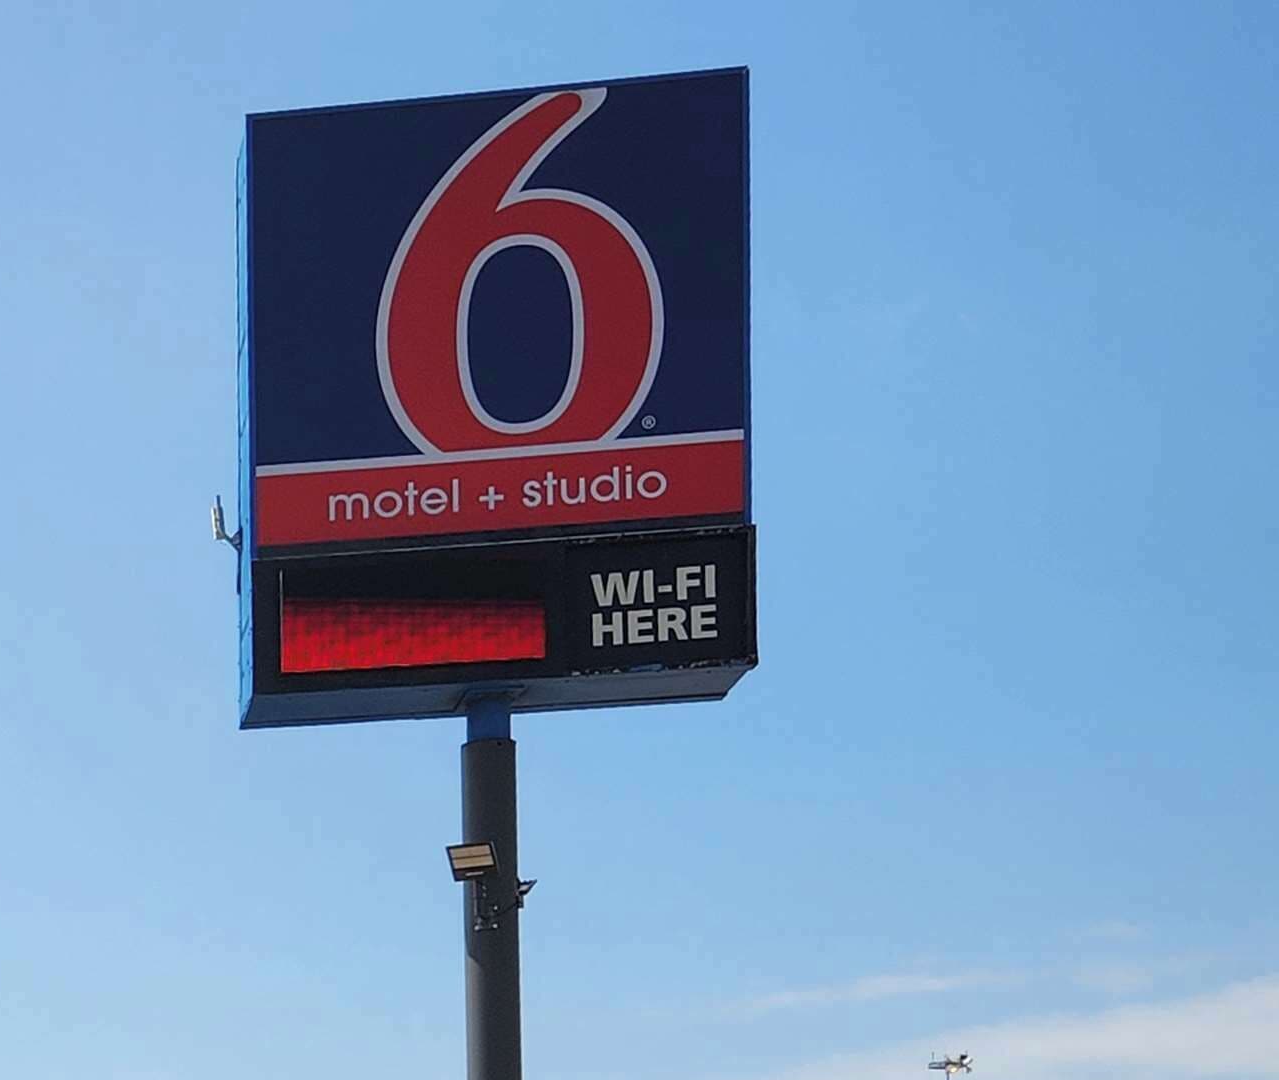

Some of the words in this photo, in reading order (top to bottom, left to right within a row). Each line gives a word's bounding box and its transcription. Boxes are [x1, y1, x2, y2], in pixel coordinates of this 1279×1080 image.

[375, 87, 665, 455] 6
[328, 478, 460, 521] motel
[479, 486, 504, 510] +
[522, 465, 668, 508] studio
[590, 564, 717, 607] WI-FI
[592, 604, 719, 647] HERE
